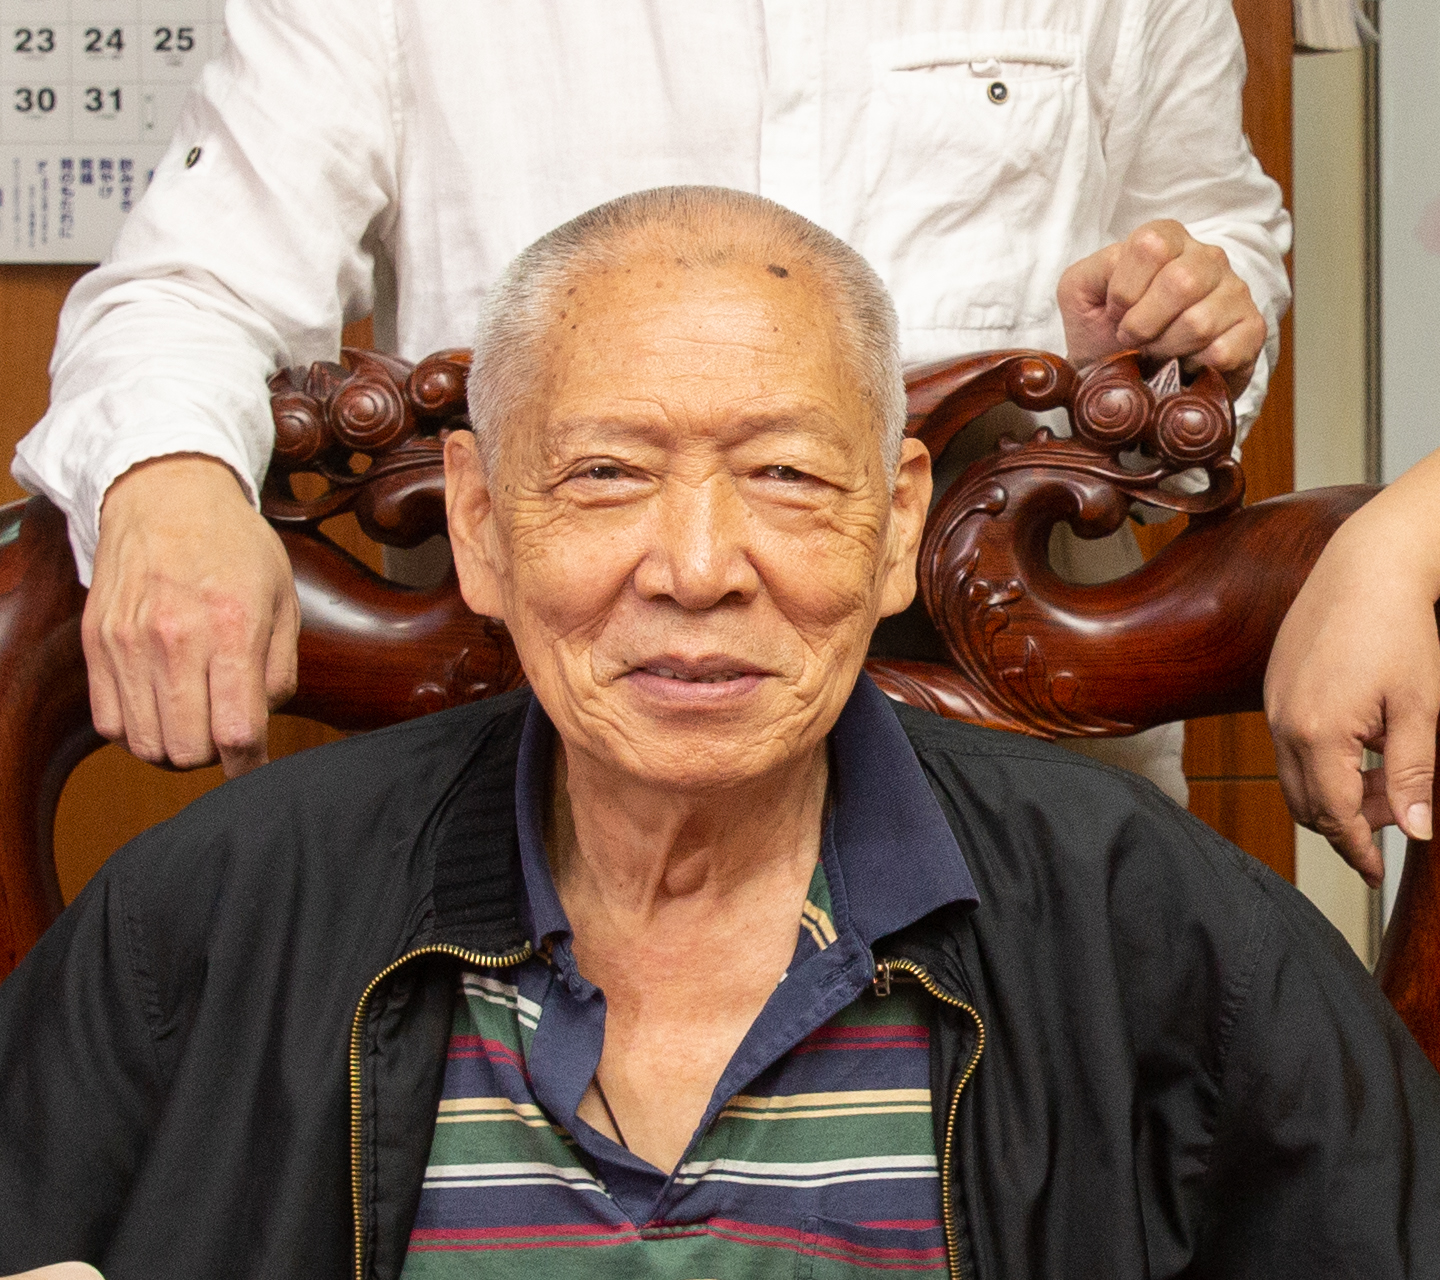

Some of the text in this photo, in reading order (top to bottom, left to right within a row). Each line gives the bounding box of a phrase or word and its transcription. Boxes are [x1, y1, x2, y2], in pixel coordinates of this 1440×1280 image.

[15, 28, 55, 53] 23
[85, 28, 124, 53] 24
[155, 27, 195, 52] 25
[16, 87, 56, 112] 30
[85, 87, 121, 112] 31
